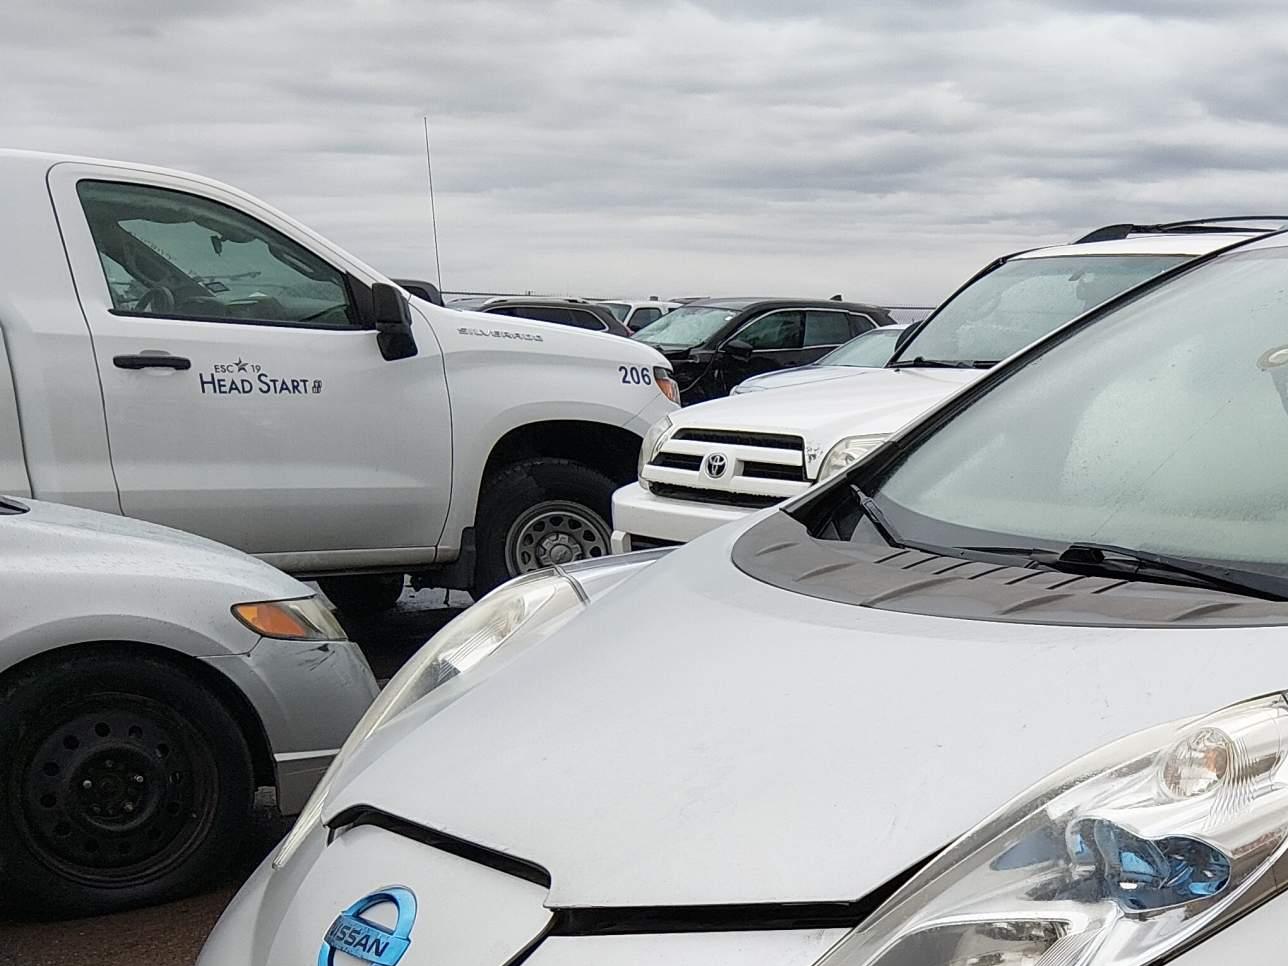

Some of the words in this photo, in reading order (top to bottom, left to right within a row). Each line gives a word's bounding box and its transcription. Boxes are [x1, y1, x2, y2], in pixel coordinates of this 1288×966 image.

[214, 364, 234, 373] ESC
[250, 364, 261, 373] 19
[618, 365, 651, 386] 206
[199, 373, 253, 394] HEAD
[257, 373, 309, 394] START
